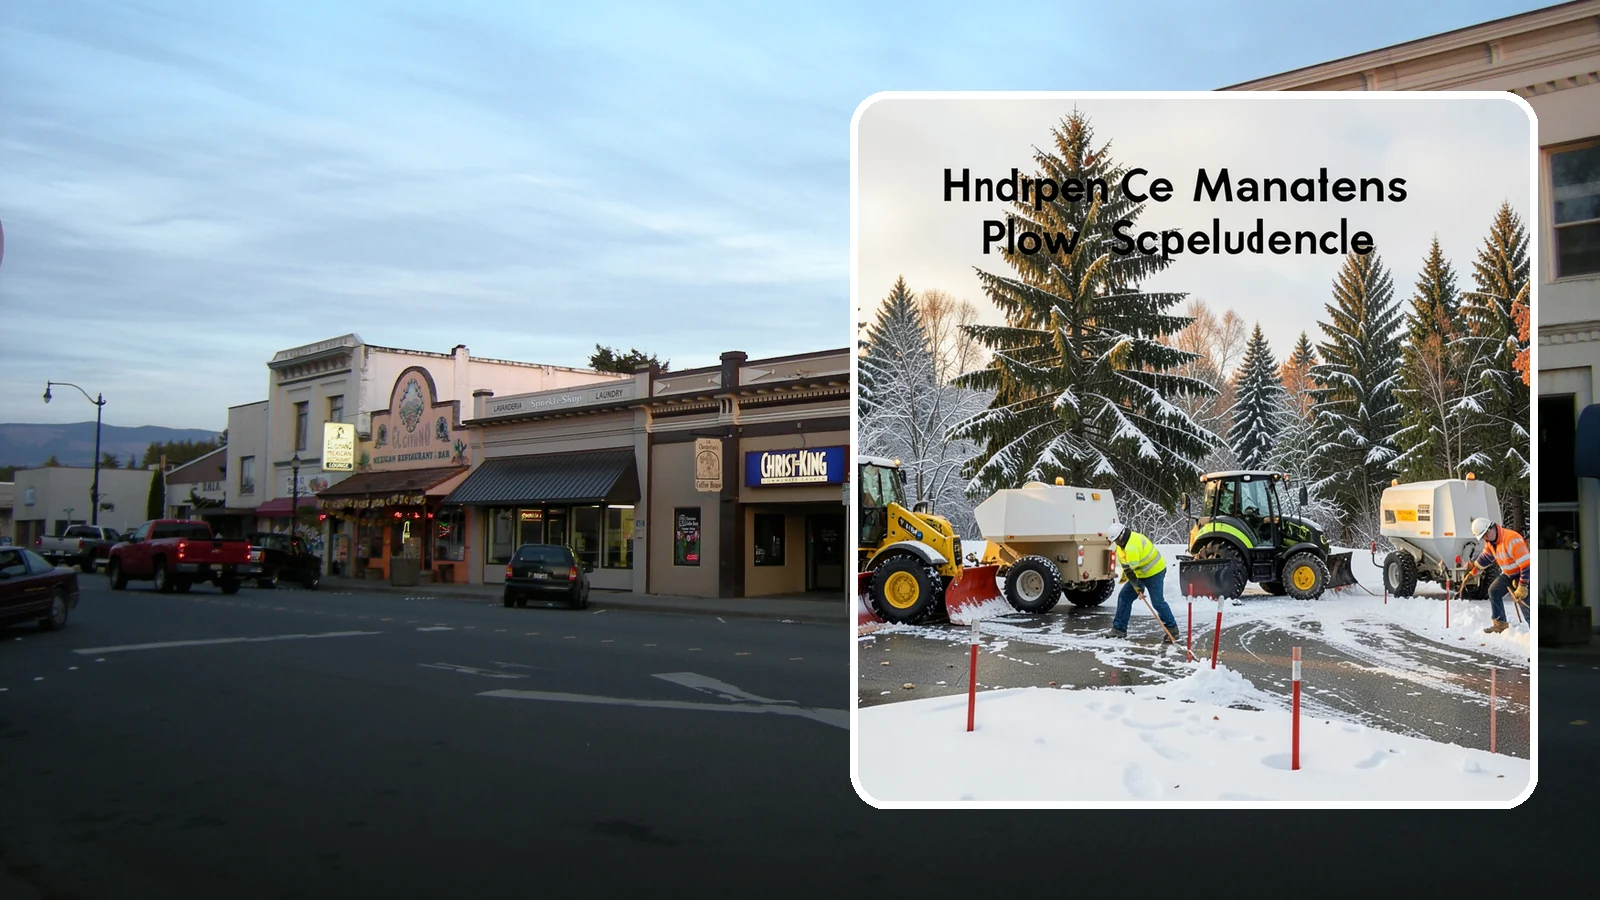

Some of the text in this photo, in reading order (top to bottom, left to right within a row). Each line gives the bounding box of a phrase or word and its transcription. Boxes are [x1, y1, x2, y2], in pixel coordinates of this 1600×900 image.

[493, 402, 523, 413] LAVANDERIA
[595, 388, 624, 400] LAUNDRY
[373, 455, 396, 464] MEXICAN
[397, 451, 433, 462] RESTAURANT
[437, 450, 450, 459] BAR
[760, 452, 797, 478] CHRIST
[799, 449, 827, 476] KING
